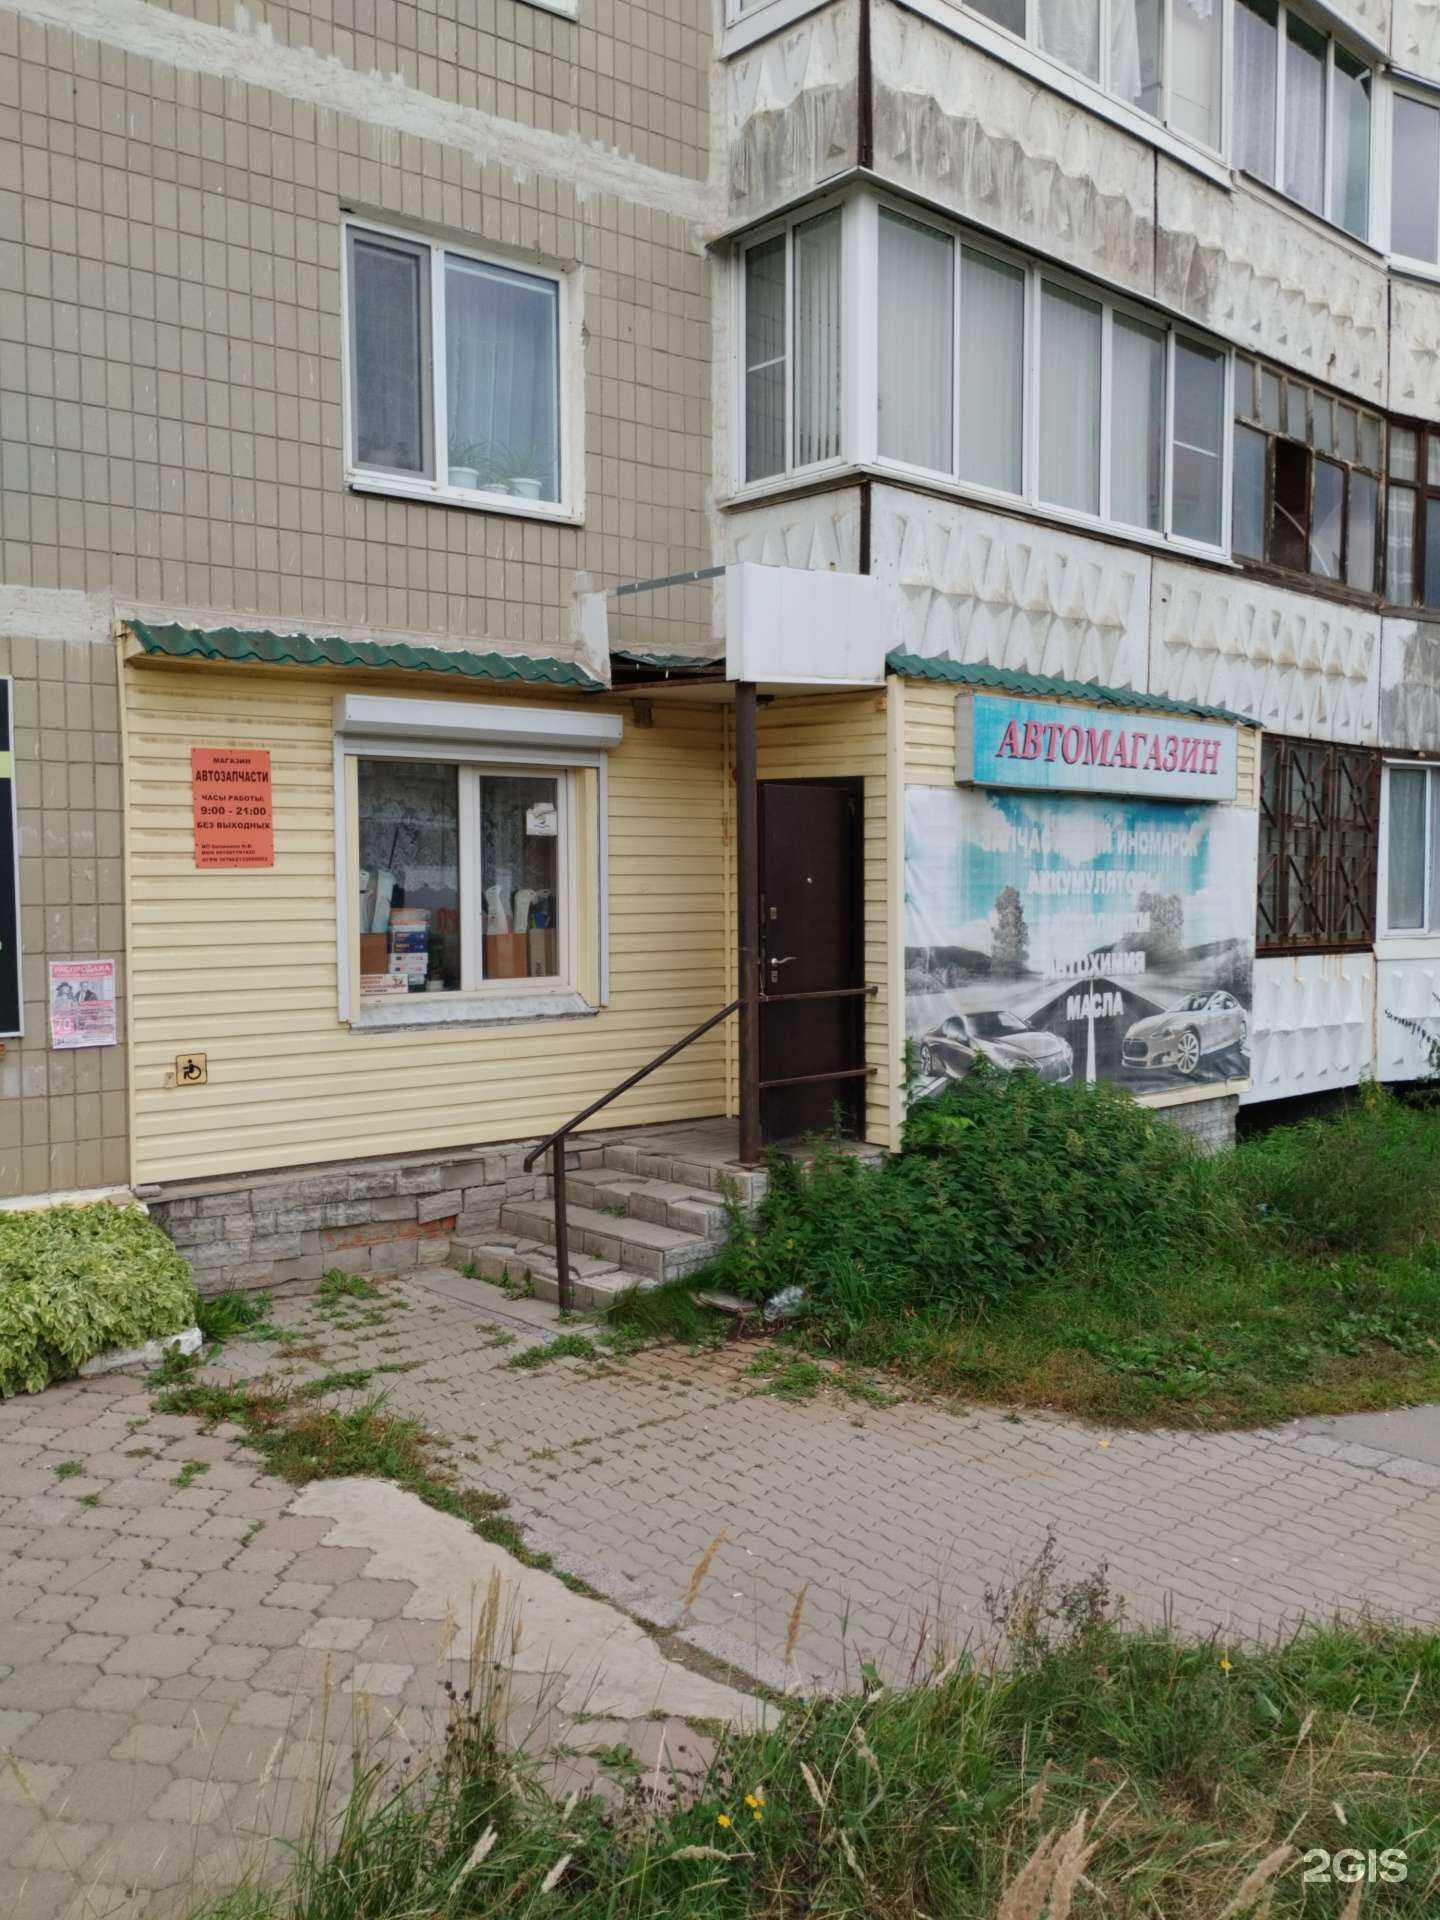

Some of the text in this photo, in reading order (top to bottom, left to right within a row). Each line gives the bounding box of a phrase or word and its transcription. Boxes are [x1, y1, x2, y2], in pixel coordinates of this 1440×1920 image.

[995, 720, 1222, 775] АВТОМАГАЗИН
[195, 771, 269, 782] АВТОЗАПЧАСТИ
[201, 794, 226, 802] ЧАСЫ
[200, 806, 225, 815] 9:00
[236, 806, 266, 816] 21:00
[197, 821, 271, 831] БЕЗ ВЫХОДНЫХ
[1117, 830, 1199, 857] ИНОМАРОК
[1045, 951, 1146, 979] АВТОХИМИЯ
[1066, 991, 1125, 1021] МАСЛА
